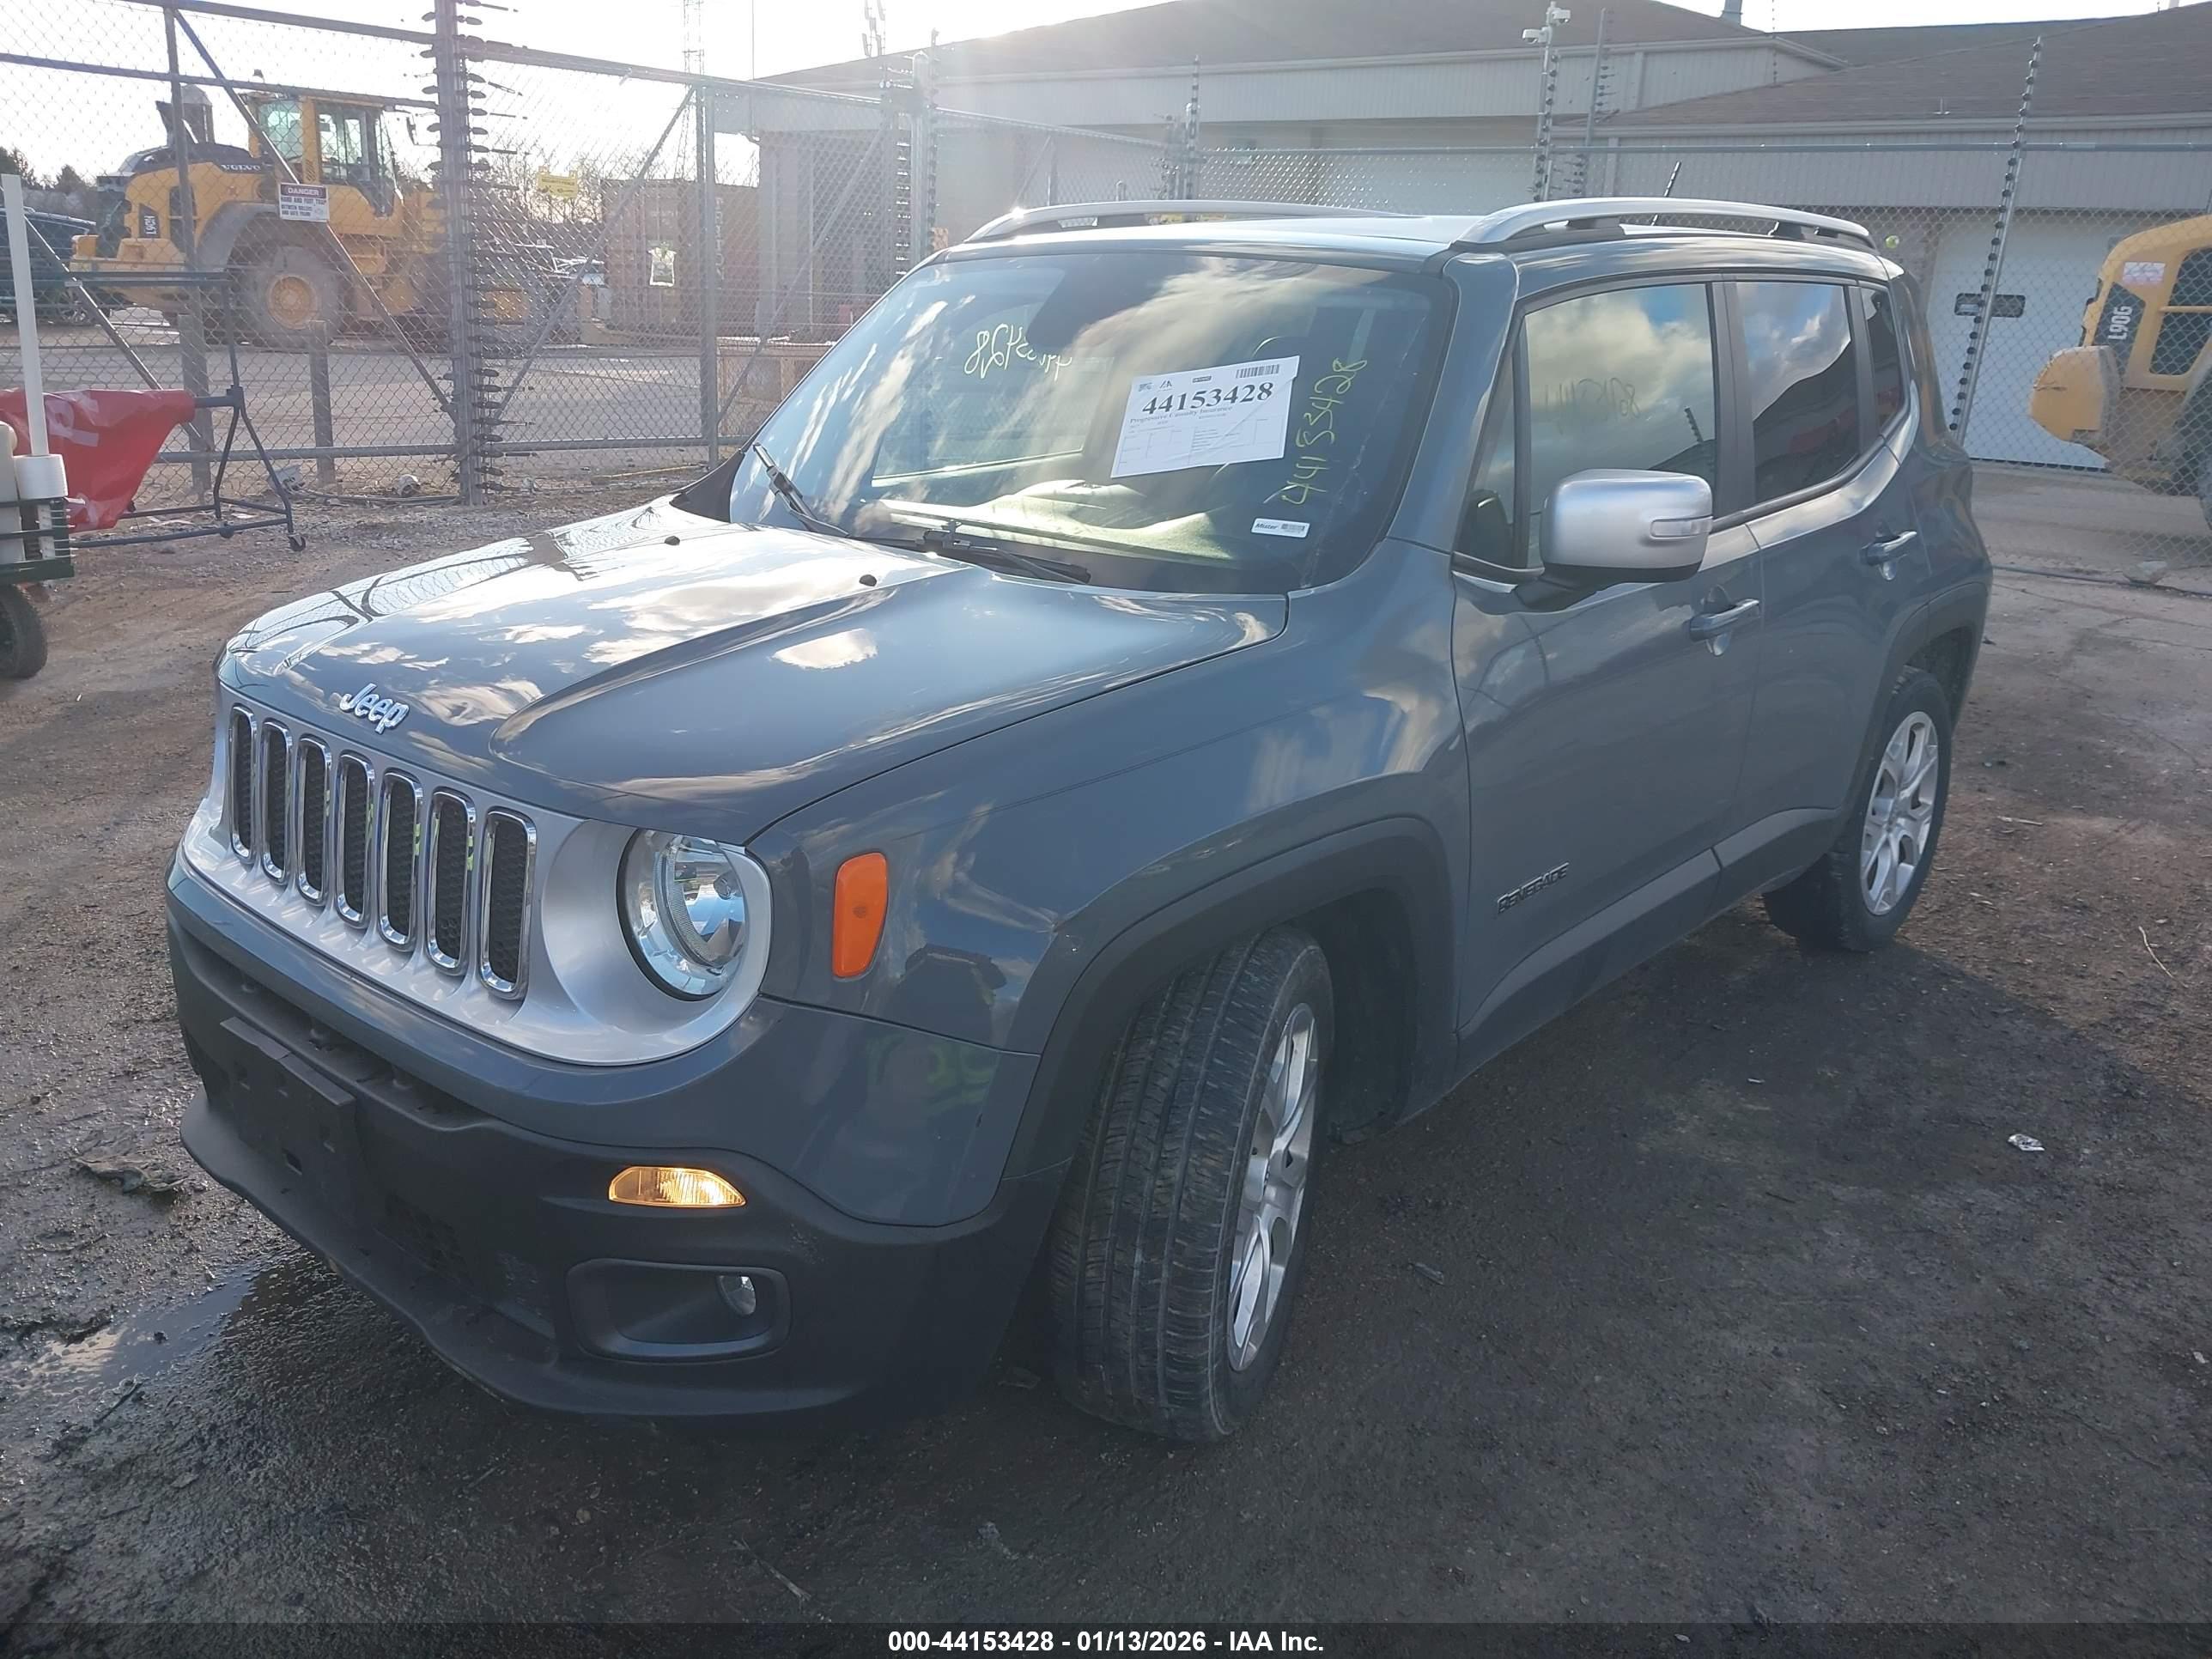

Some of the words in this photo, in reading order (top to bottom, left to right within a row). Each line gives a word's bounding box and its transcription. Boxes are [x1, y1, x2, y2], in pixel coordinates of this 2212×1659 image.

[288, 187, 319, 196] DANGER
[2106, 306, 2133, 340] L90G
[1142, 382, 1274, 415] 44153428
[1280, 357, 1369, 505] 44153428
[338, 682, 410, 734] Jeep
[1497, 861, 1571, 913] RENEGADE
